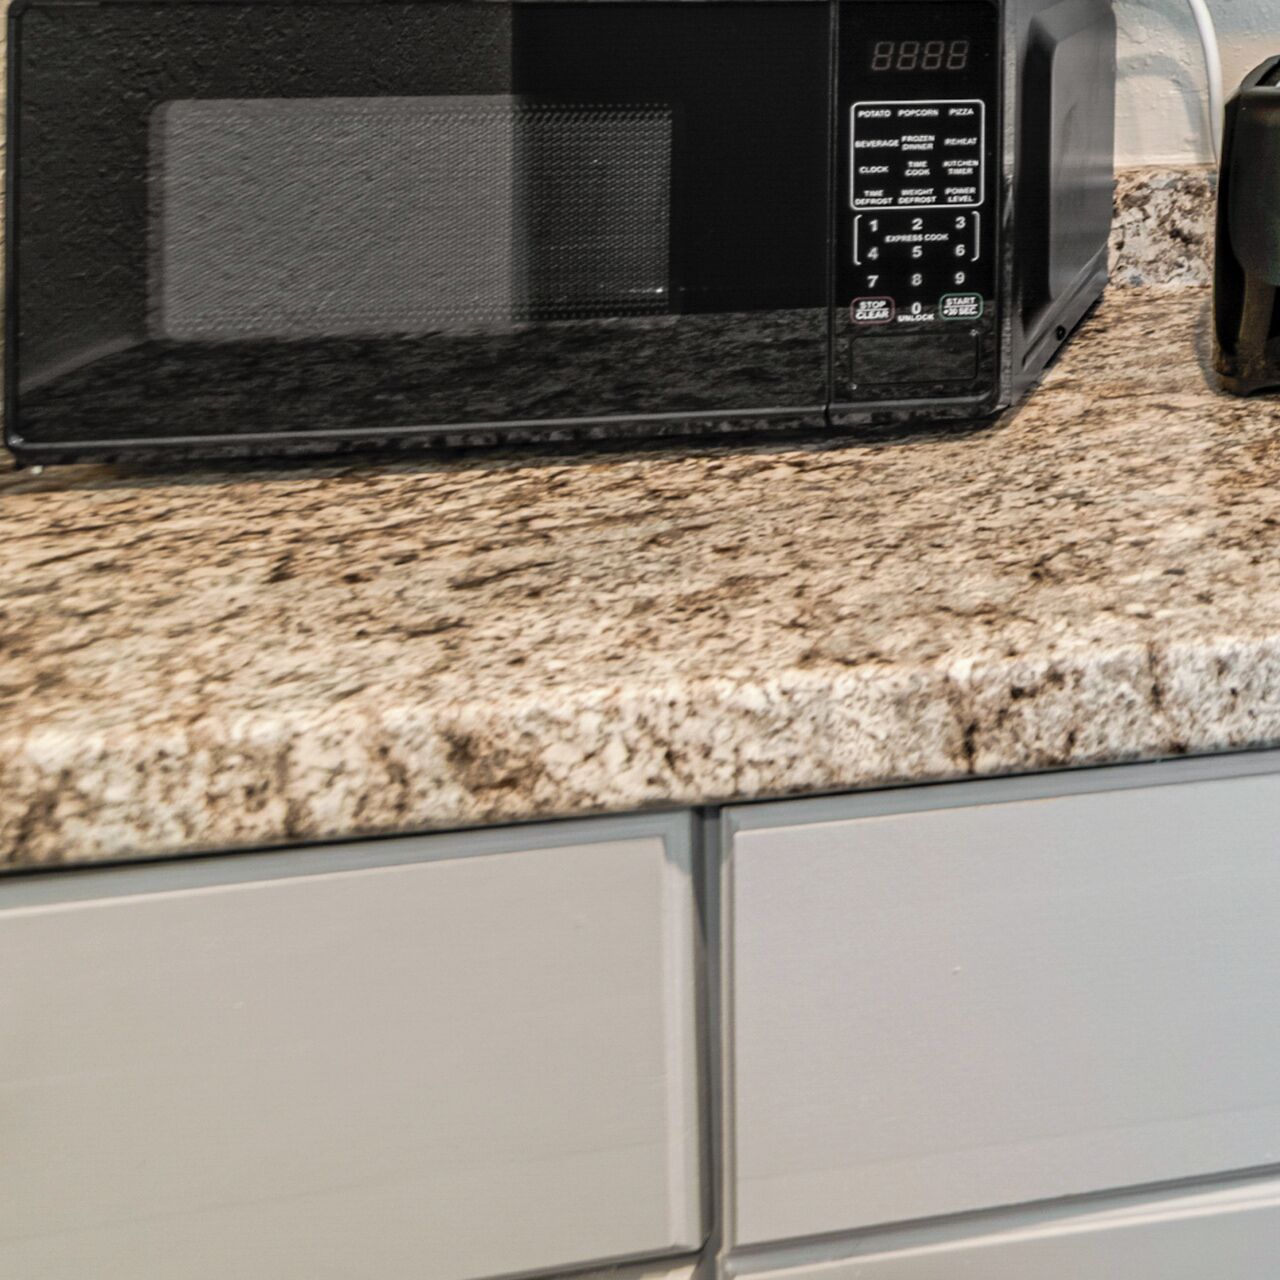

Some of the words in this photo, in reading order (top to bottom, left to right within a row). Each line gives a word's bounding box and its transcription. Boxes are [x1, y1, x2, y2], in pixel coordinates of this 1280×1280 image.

[858, 110, 891, 118] POTATO
[898, 109, 938, 117] POPCORN
[949, 108, 974, 116] PIZZA
[855, 139, 899, 148] BEVERAGE
[944, 137, 977, 145] REHEAT
[902, 143, 933, 151] DINNER
[859, 166, 889, 174] CLOCK
[901, 188, 934, 196] WEIGHT
[945, 187, 976, 195] POWER
[855, 197, 893, 205] DEFROST
[898, 196, 937, 204] DEFROST
[948, 195, 973, 203] LEVEL
[869, 219, 879, 232] 1
[911, 218, 923, 231] 2
[955, 216, 966, 229] 3
[884, 235, 923, 243] EXPRESS
[924, 233, 949, 241] COOK
[867, 247, 879, 259] 4
[912, 245, 922, 258] 5
[955, 244, 965, 256] 6
[867, 275, 879, 288] 7
[911, 274, 922, 286] 8
[955, 272, 965, 284] 9
[911, 302, 921, 314] 0
[856, 310, 889, 319] CLEAR
[897, 314, 934, 322] UNLOCK
